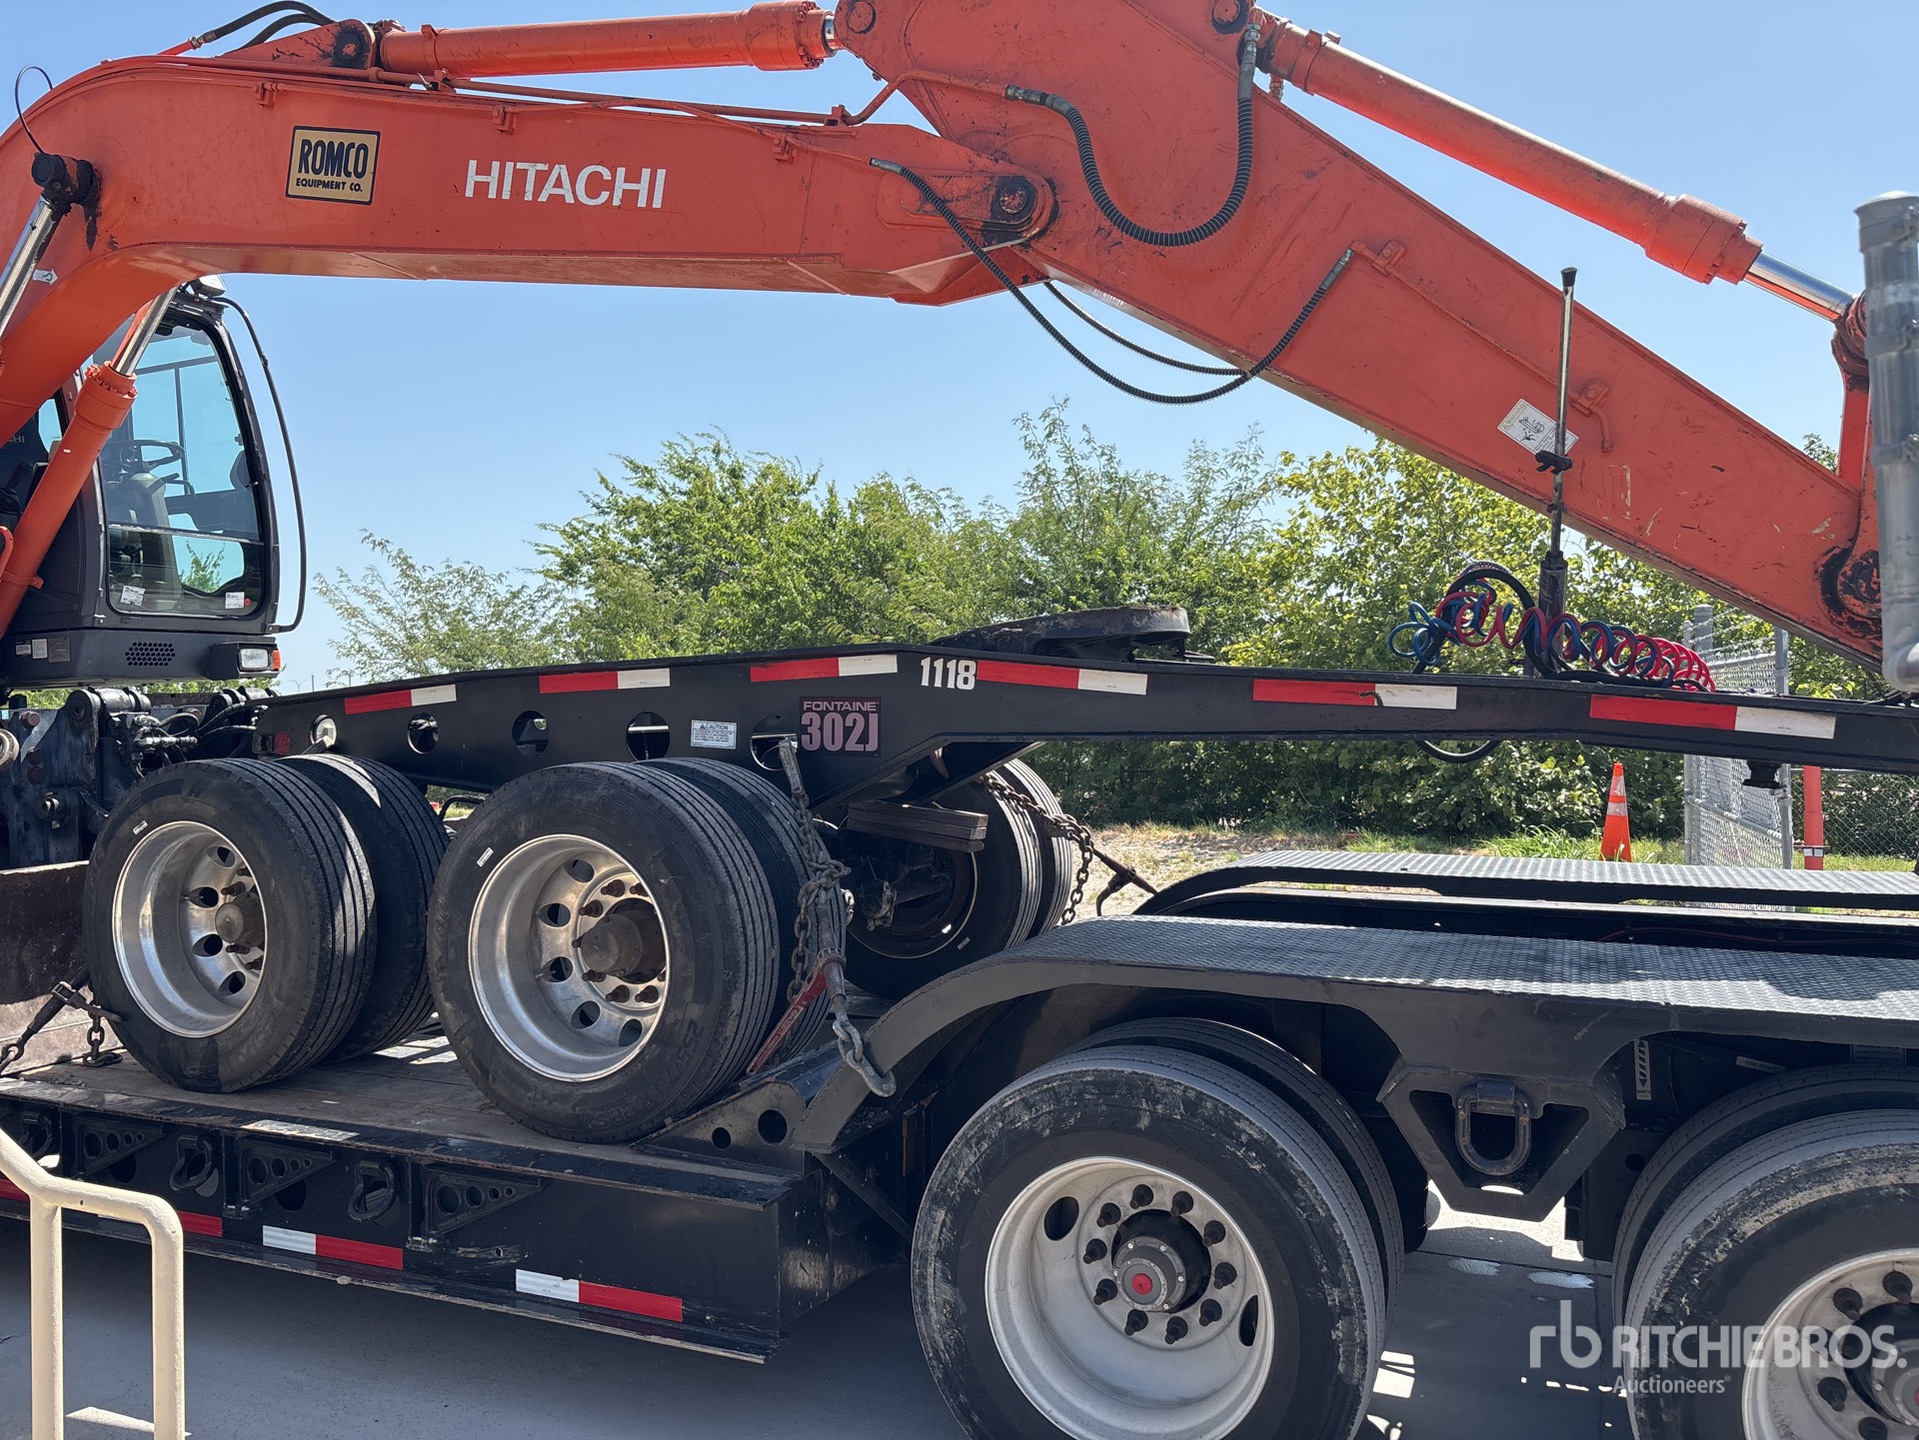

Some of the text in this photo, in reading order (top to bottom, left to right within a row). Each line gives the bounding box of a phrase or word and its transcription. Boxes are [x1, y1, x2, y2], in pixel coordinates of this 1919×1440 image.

[298, 139, 369, 179] ROMCO
[296, 178, 363, 192] EQUIPMENT CO.
[465, 160, 666, 208] HITACHI
[921, 657, 976, 690] 1118
[803, 701, 877, 711] FONTAINE
[801, 712, 878, 751] 302J
